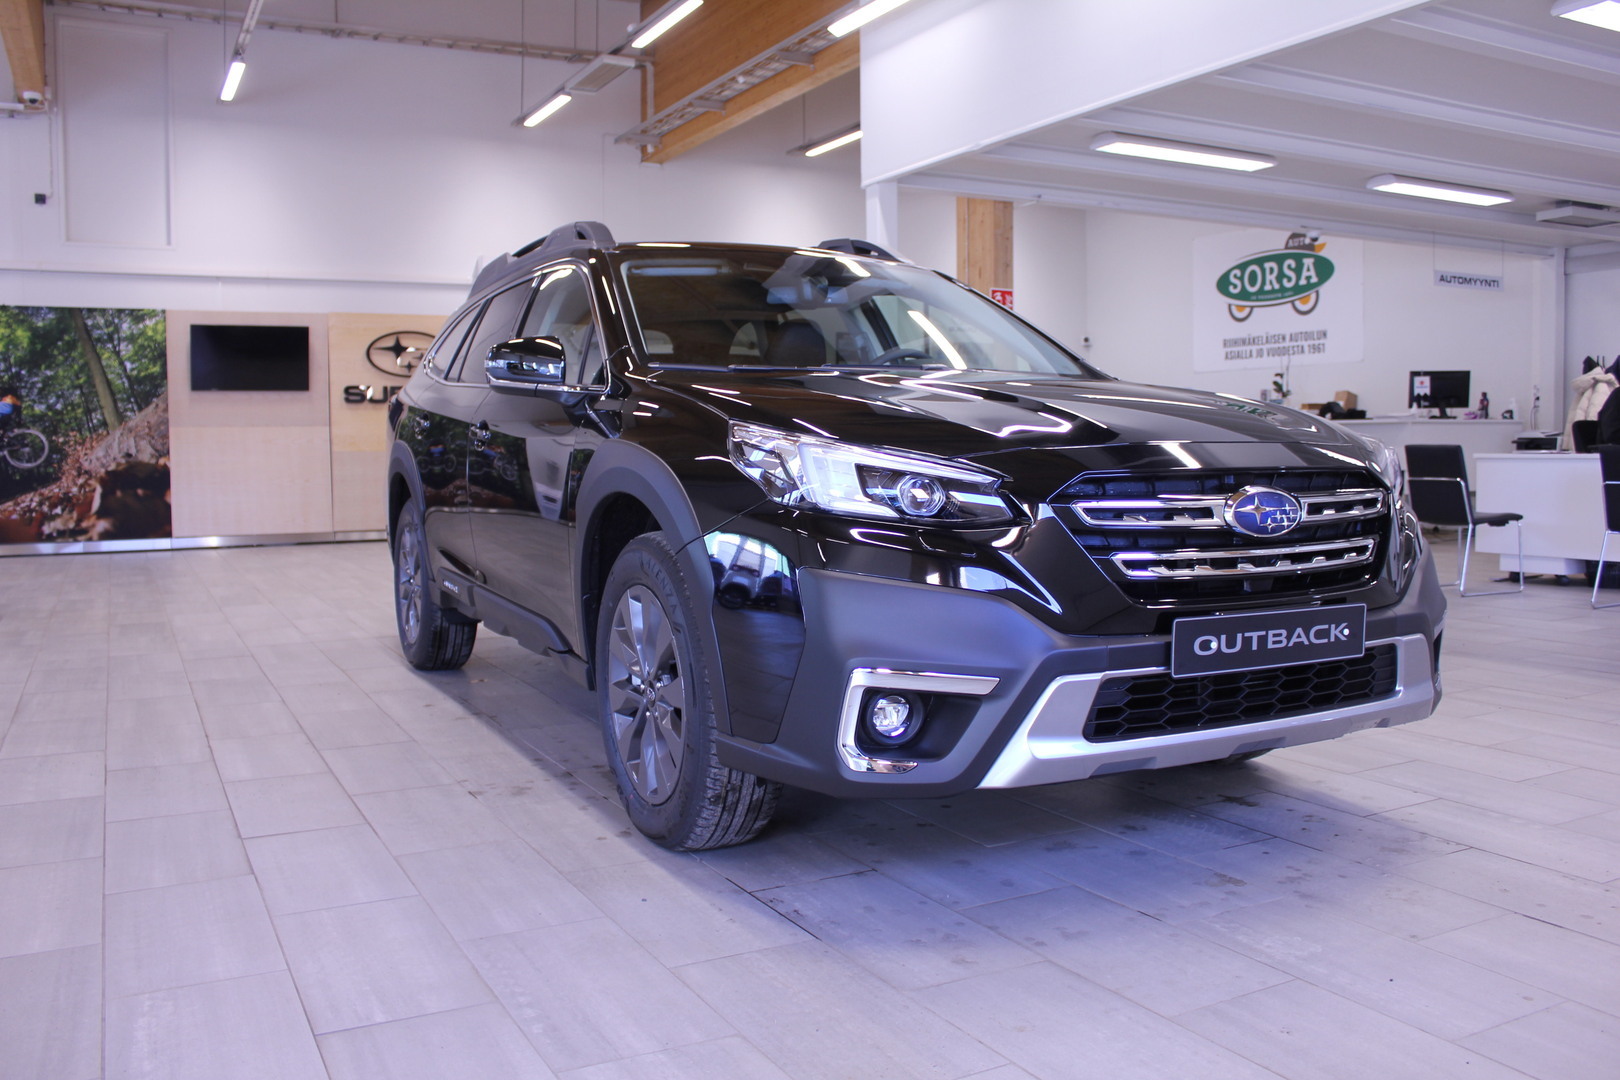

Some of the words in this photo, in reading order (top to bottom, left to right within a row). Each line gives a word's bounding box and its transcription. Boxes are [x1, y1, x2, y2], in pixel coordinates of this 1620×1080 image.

[1228, 257, 1319, 294] SORSA
[1439, 274, 1500, 288] AUTOMYYNTI
[1289, 329, 1328, 343] AUTOILUN
[1224, 348, 1254, 361] ASIALLA
[1255, 347, 1265, 359] JO
[1266, 344, 1306, 358] VUODESTA
[1193, 622, 1349, 656] OUTBACK
